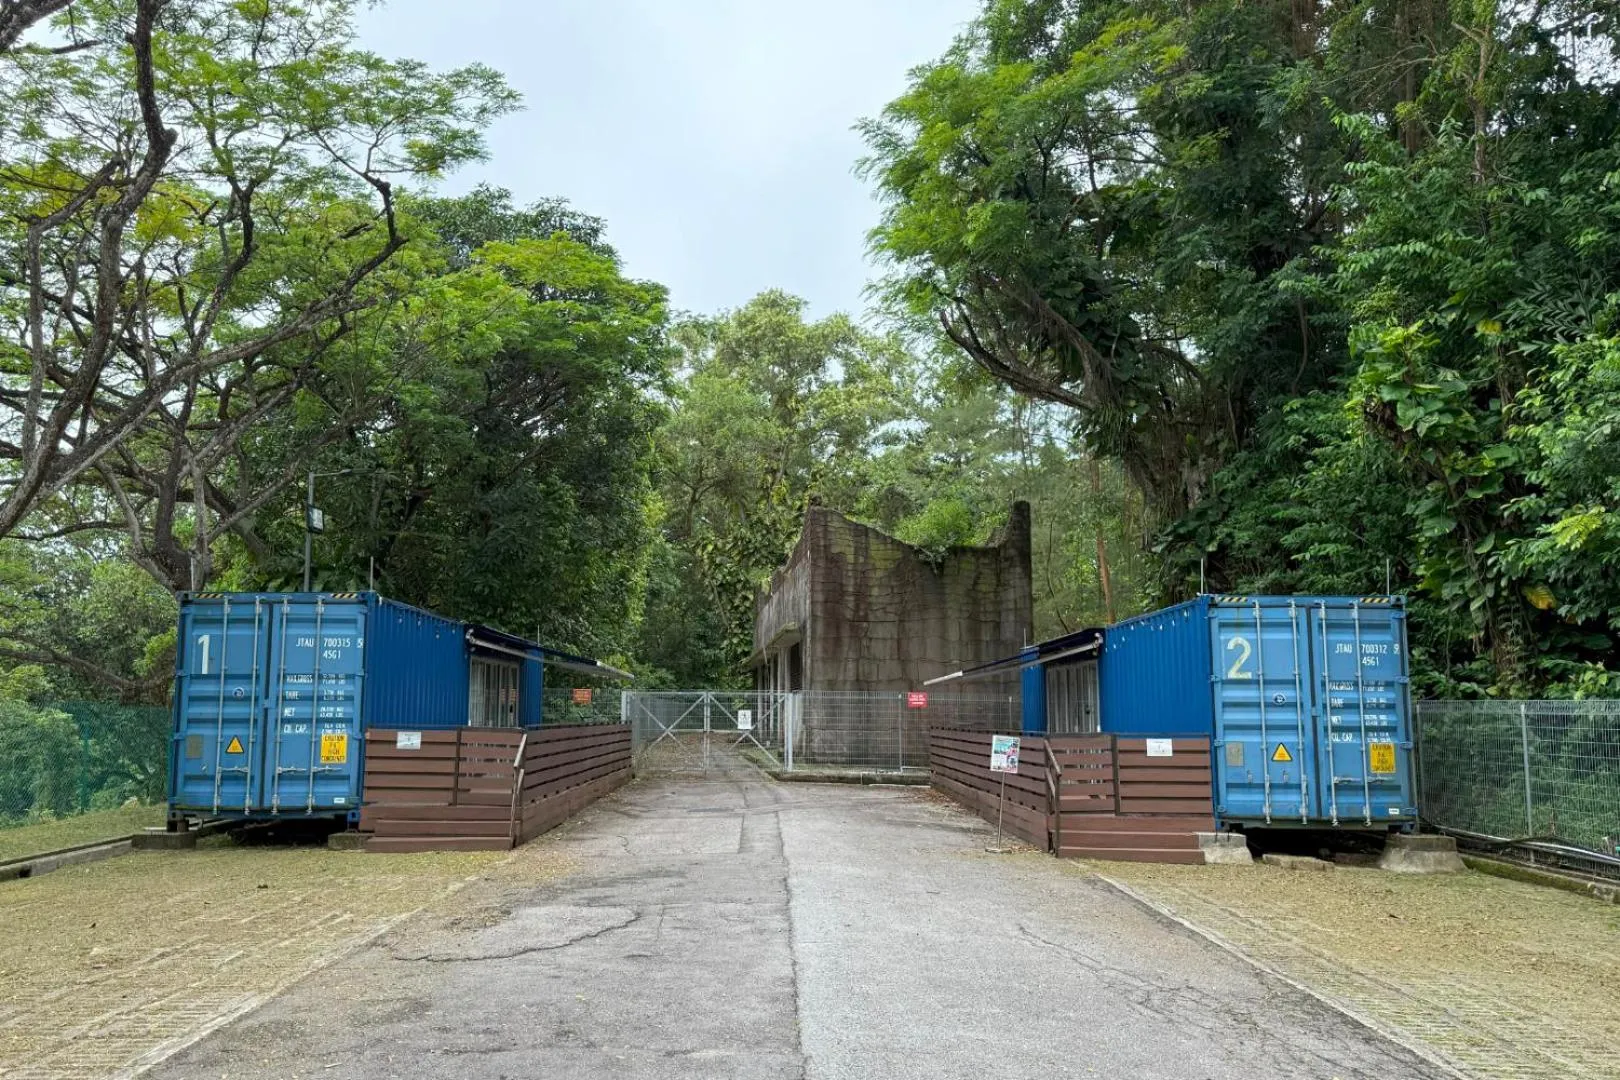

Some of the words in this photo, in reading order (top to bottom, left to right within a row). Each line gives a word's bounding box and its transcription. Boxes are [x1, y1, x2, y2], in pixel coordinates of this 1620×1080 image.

[198, 635, 210, 675] 1
[324, 638, 351, 647] 700315
[1361, 643, 1388, 654] 700312
[1227, 637, 1252, 679] 2
